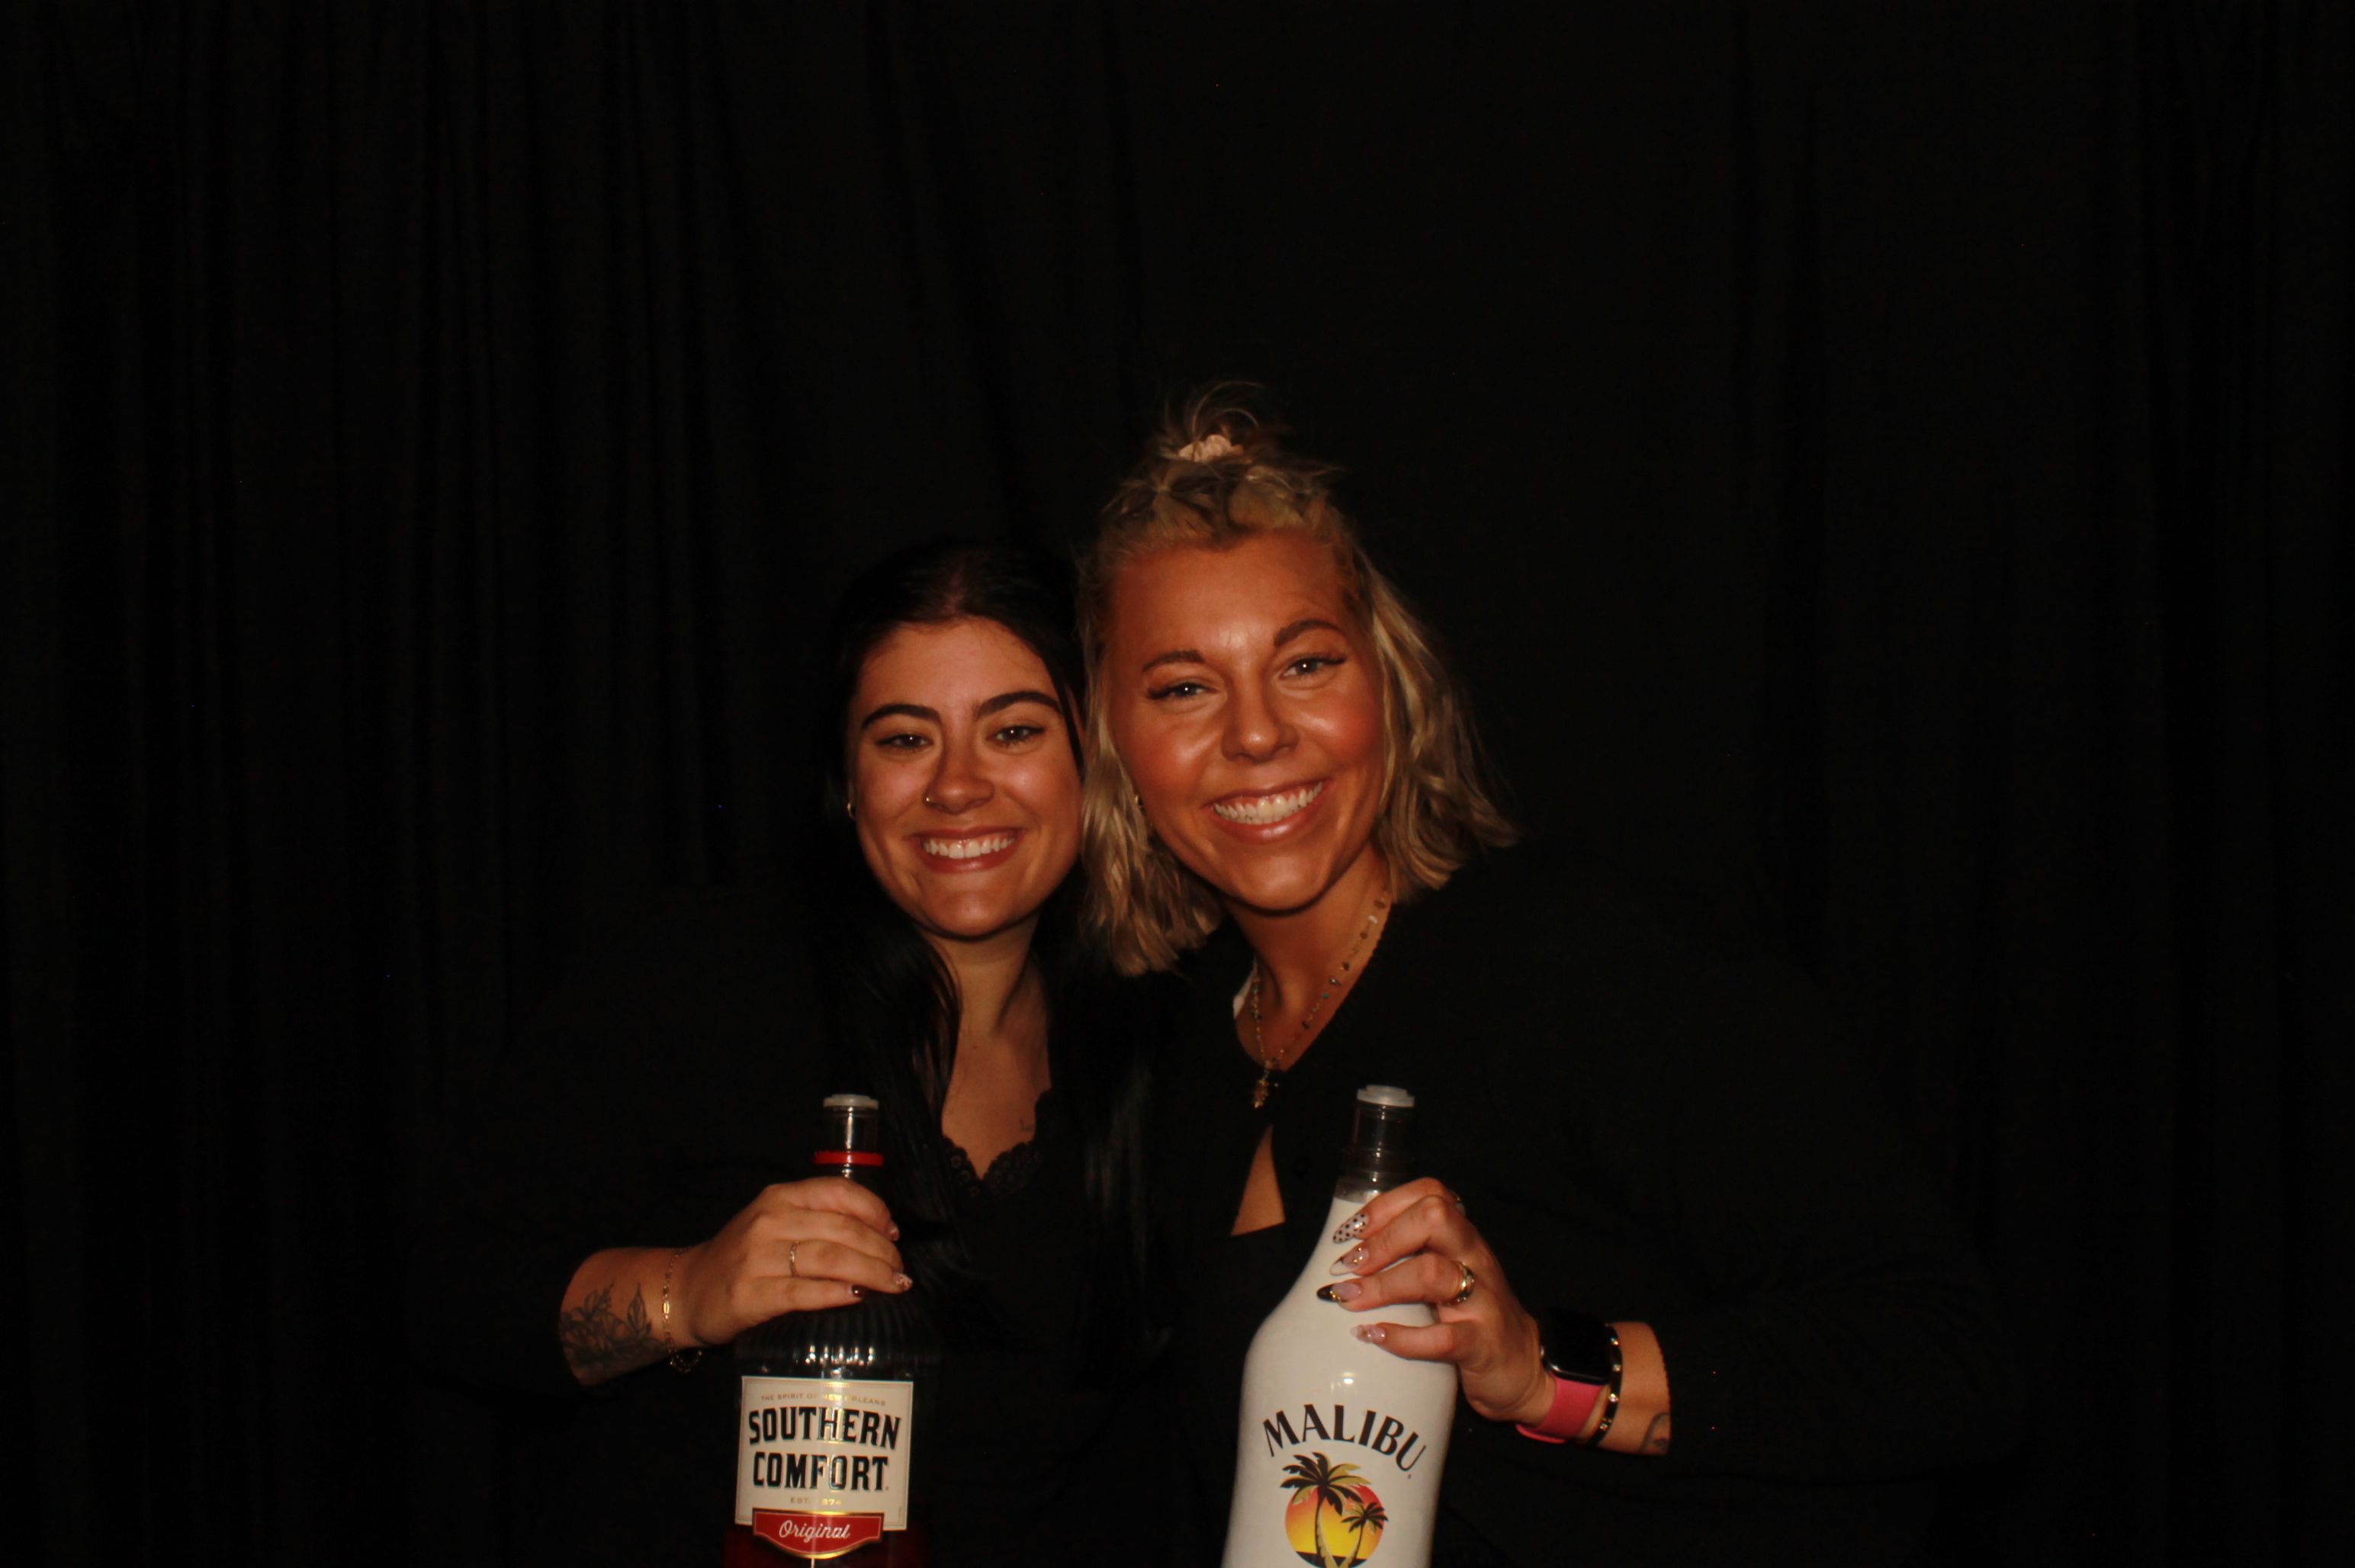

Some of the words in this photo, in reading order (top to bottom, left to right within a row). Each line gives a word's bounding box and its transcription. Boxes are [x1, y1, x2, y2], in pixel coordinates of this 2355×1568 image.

[822, 1393, 842, 1401] NEW
[748, 1406, 902, 1450] SOUTHERN
[1262, 1403, 1427, 1473] MALIBU
[753, 1451, 889, 1491] COMFORT
[818, 1498, 842, 1506] 874
[778, 1519, 851, 1543] Original
